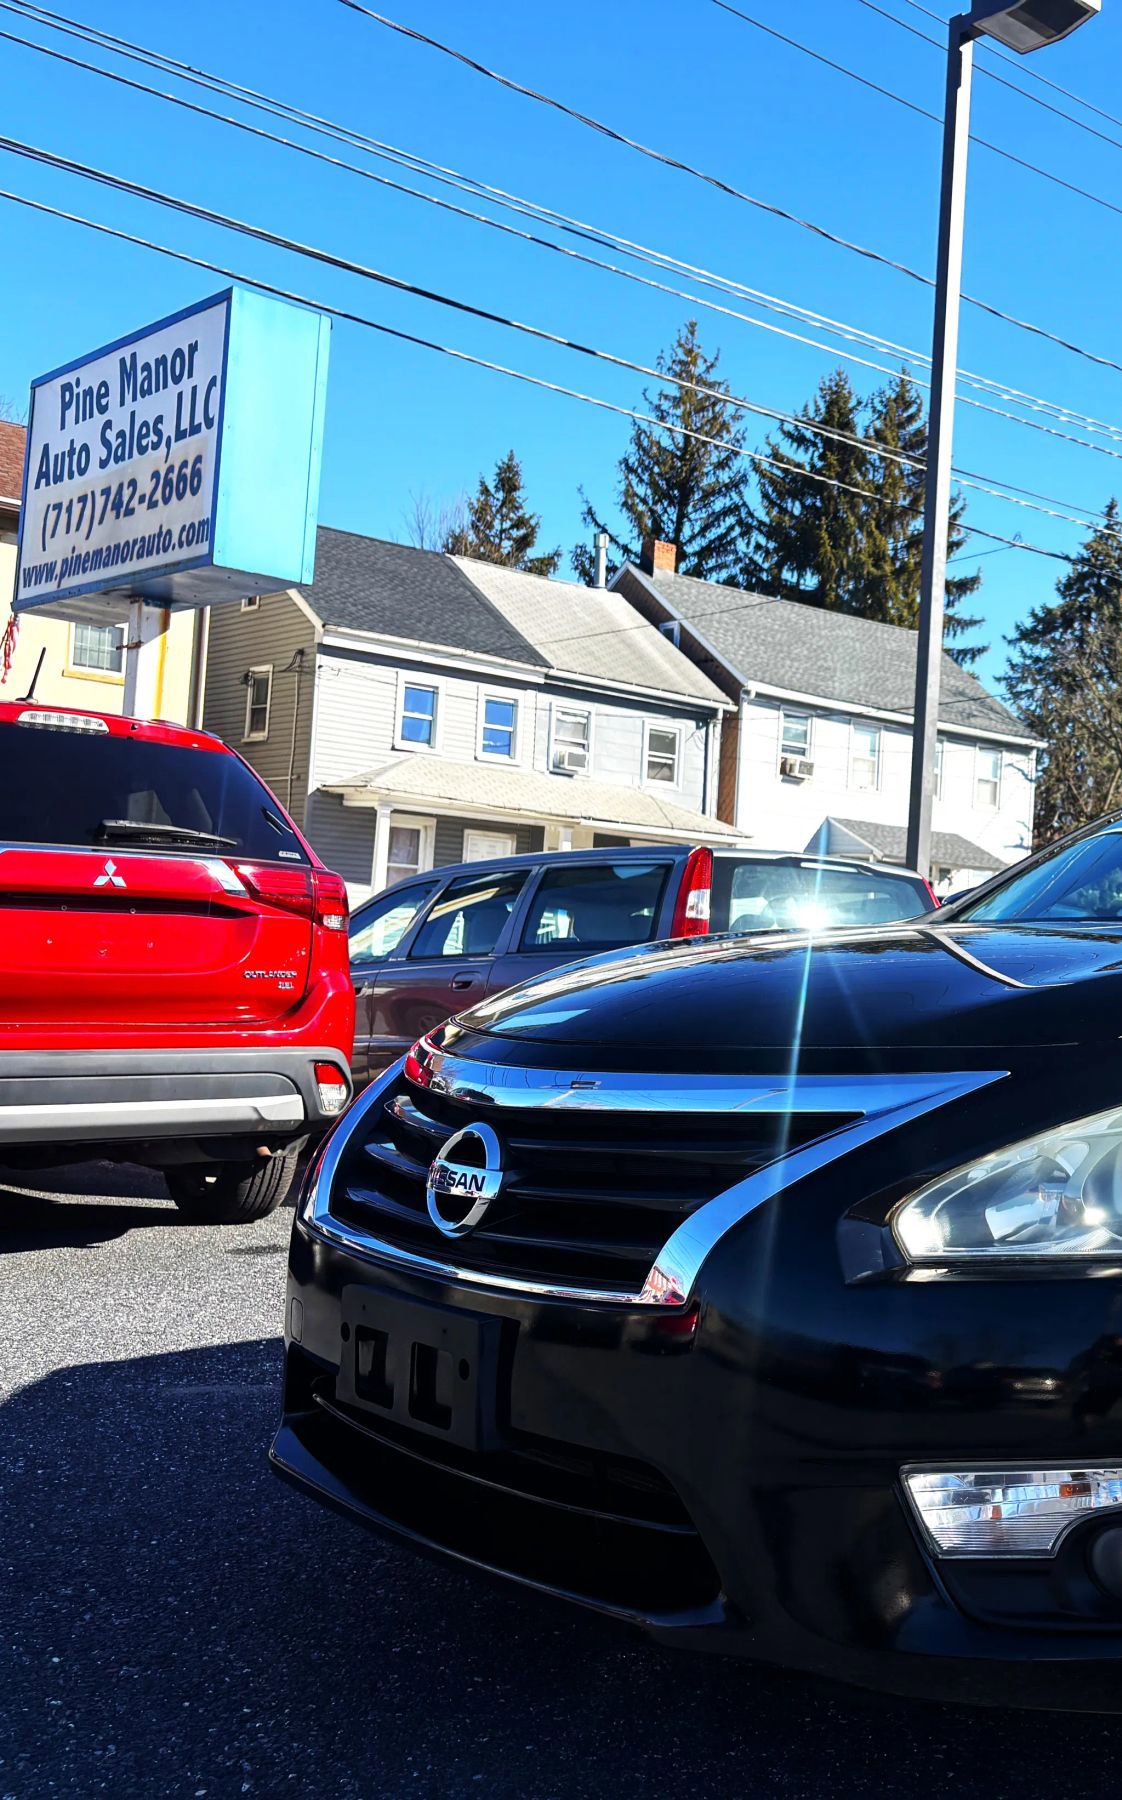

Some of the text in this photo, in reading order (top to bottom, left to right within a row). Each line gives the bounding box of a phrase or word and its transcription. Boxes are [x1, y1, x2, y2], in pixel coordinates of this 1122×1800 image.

[60, 339, 198, 431] Pine Manor
[34, 442, 90, 490] Auto
[22, 517, 210, 589] www.pinemanorauto.com
